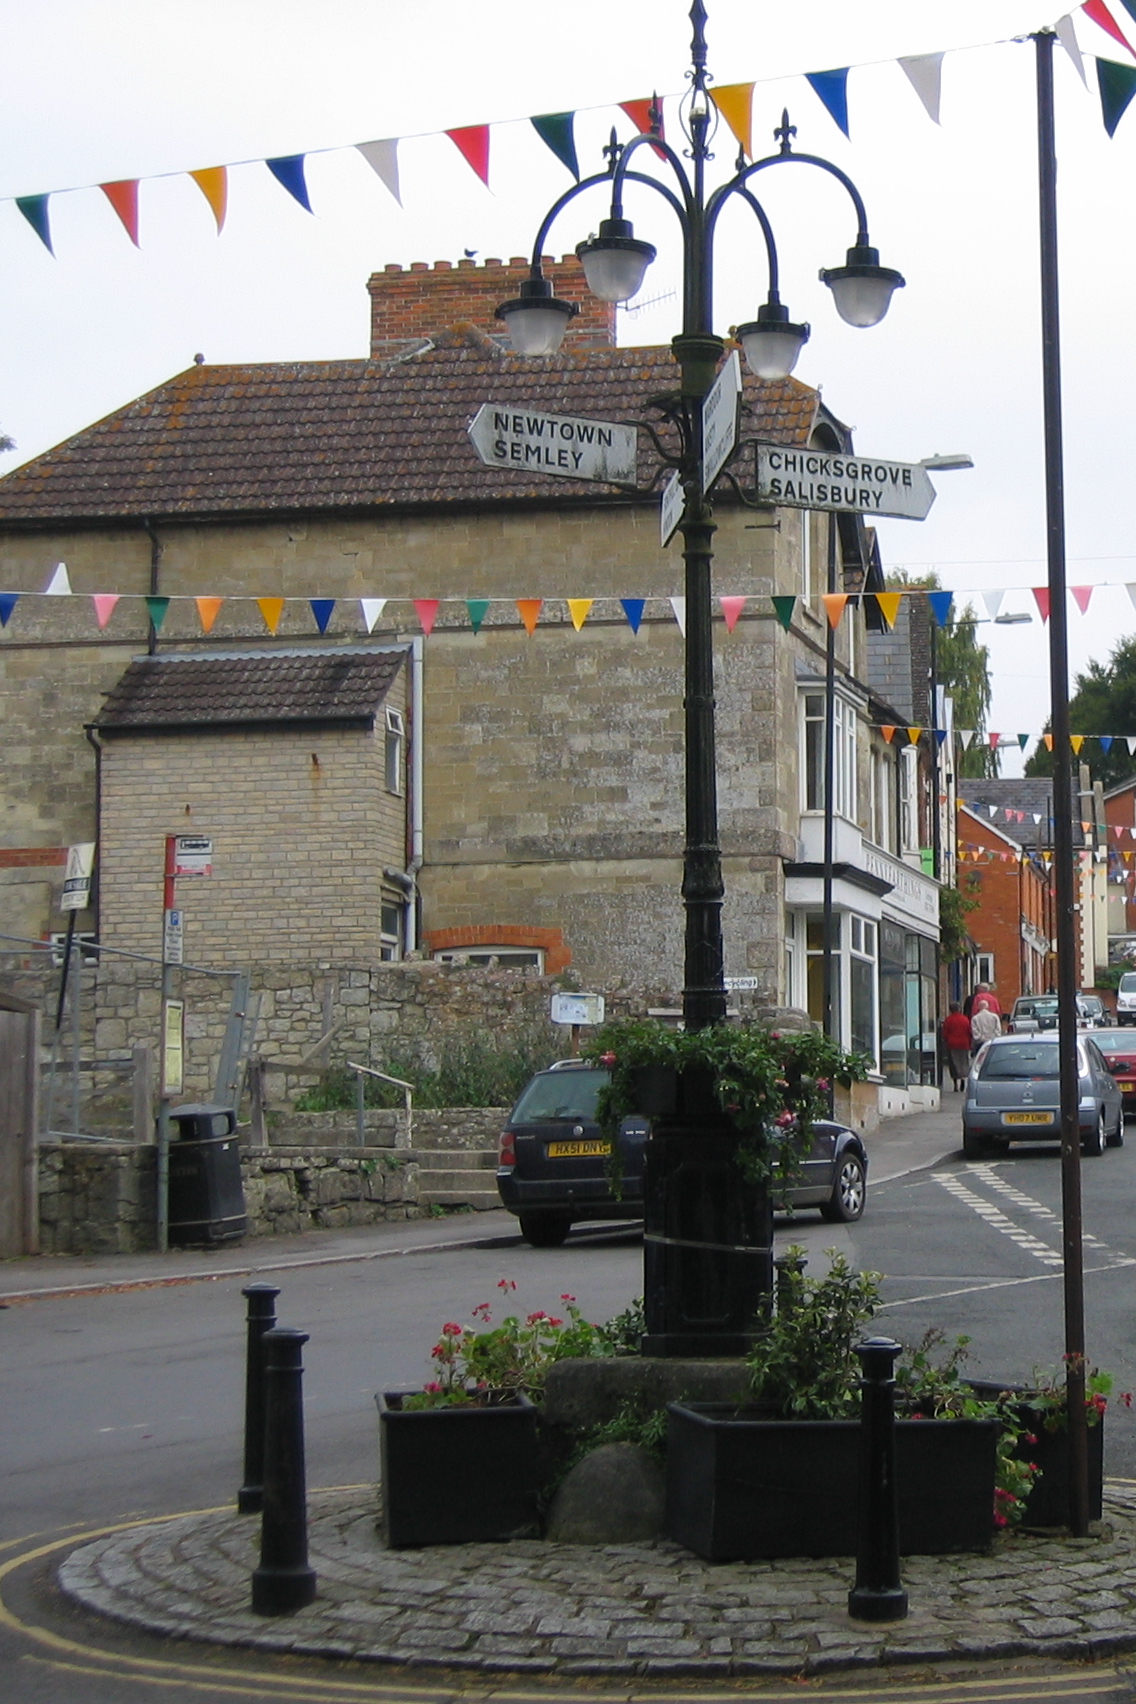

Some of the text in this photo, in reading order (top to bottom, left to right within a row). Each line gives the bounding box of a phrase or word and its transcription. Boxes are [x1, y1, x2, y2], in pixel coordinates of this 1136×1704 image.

[494, 412, 612, 447] NEWTOWN
[494, 440, 584, 469] SEMLEY
[769, 453, 912, 486] CHICKSGROVE
[770, 478, 883, 508] SALISBURY
[723, 978, 753, 988] ecycling
[556, 1142, 580, 1155] HX51
